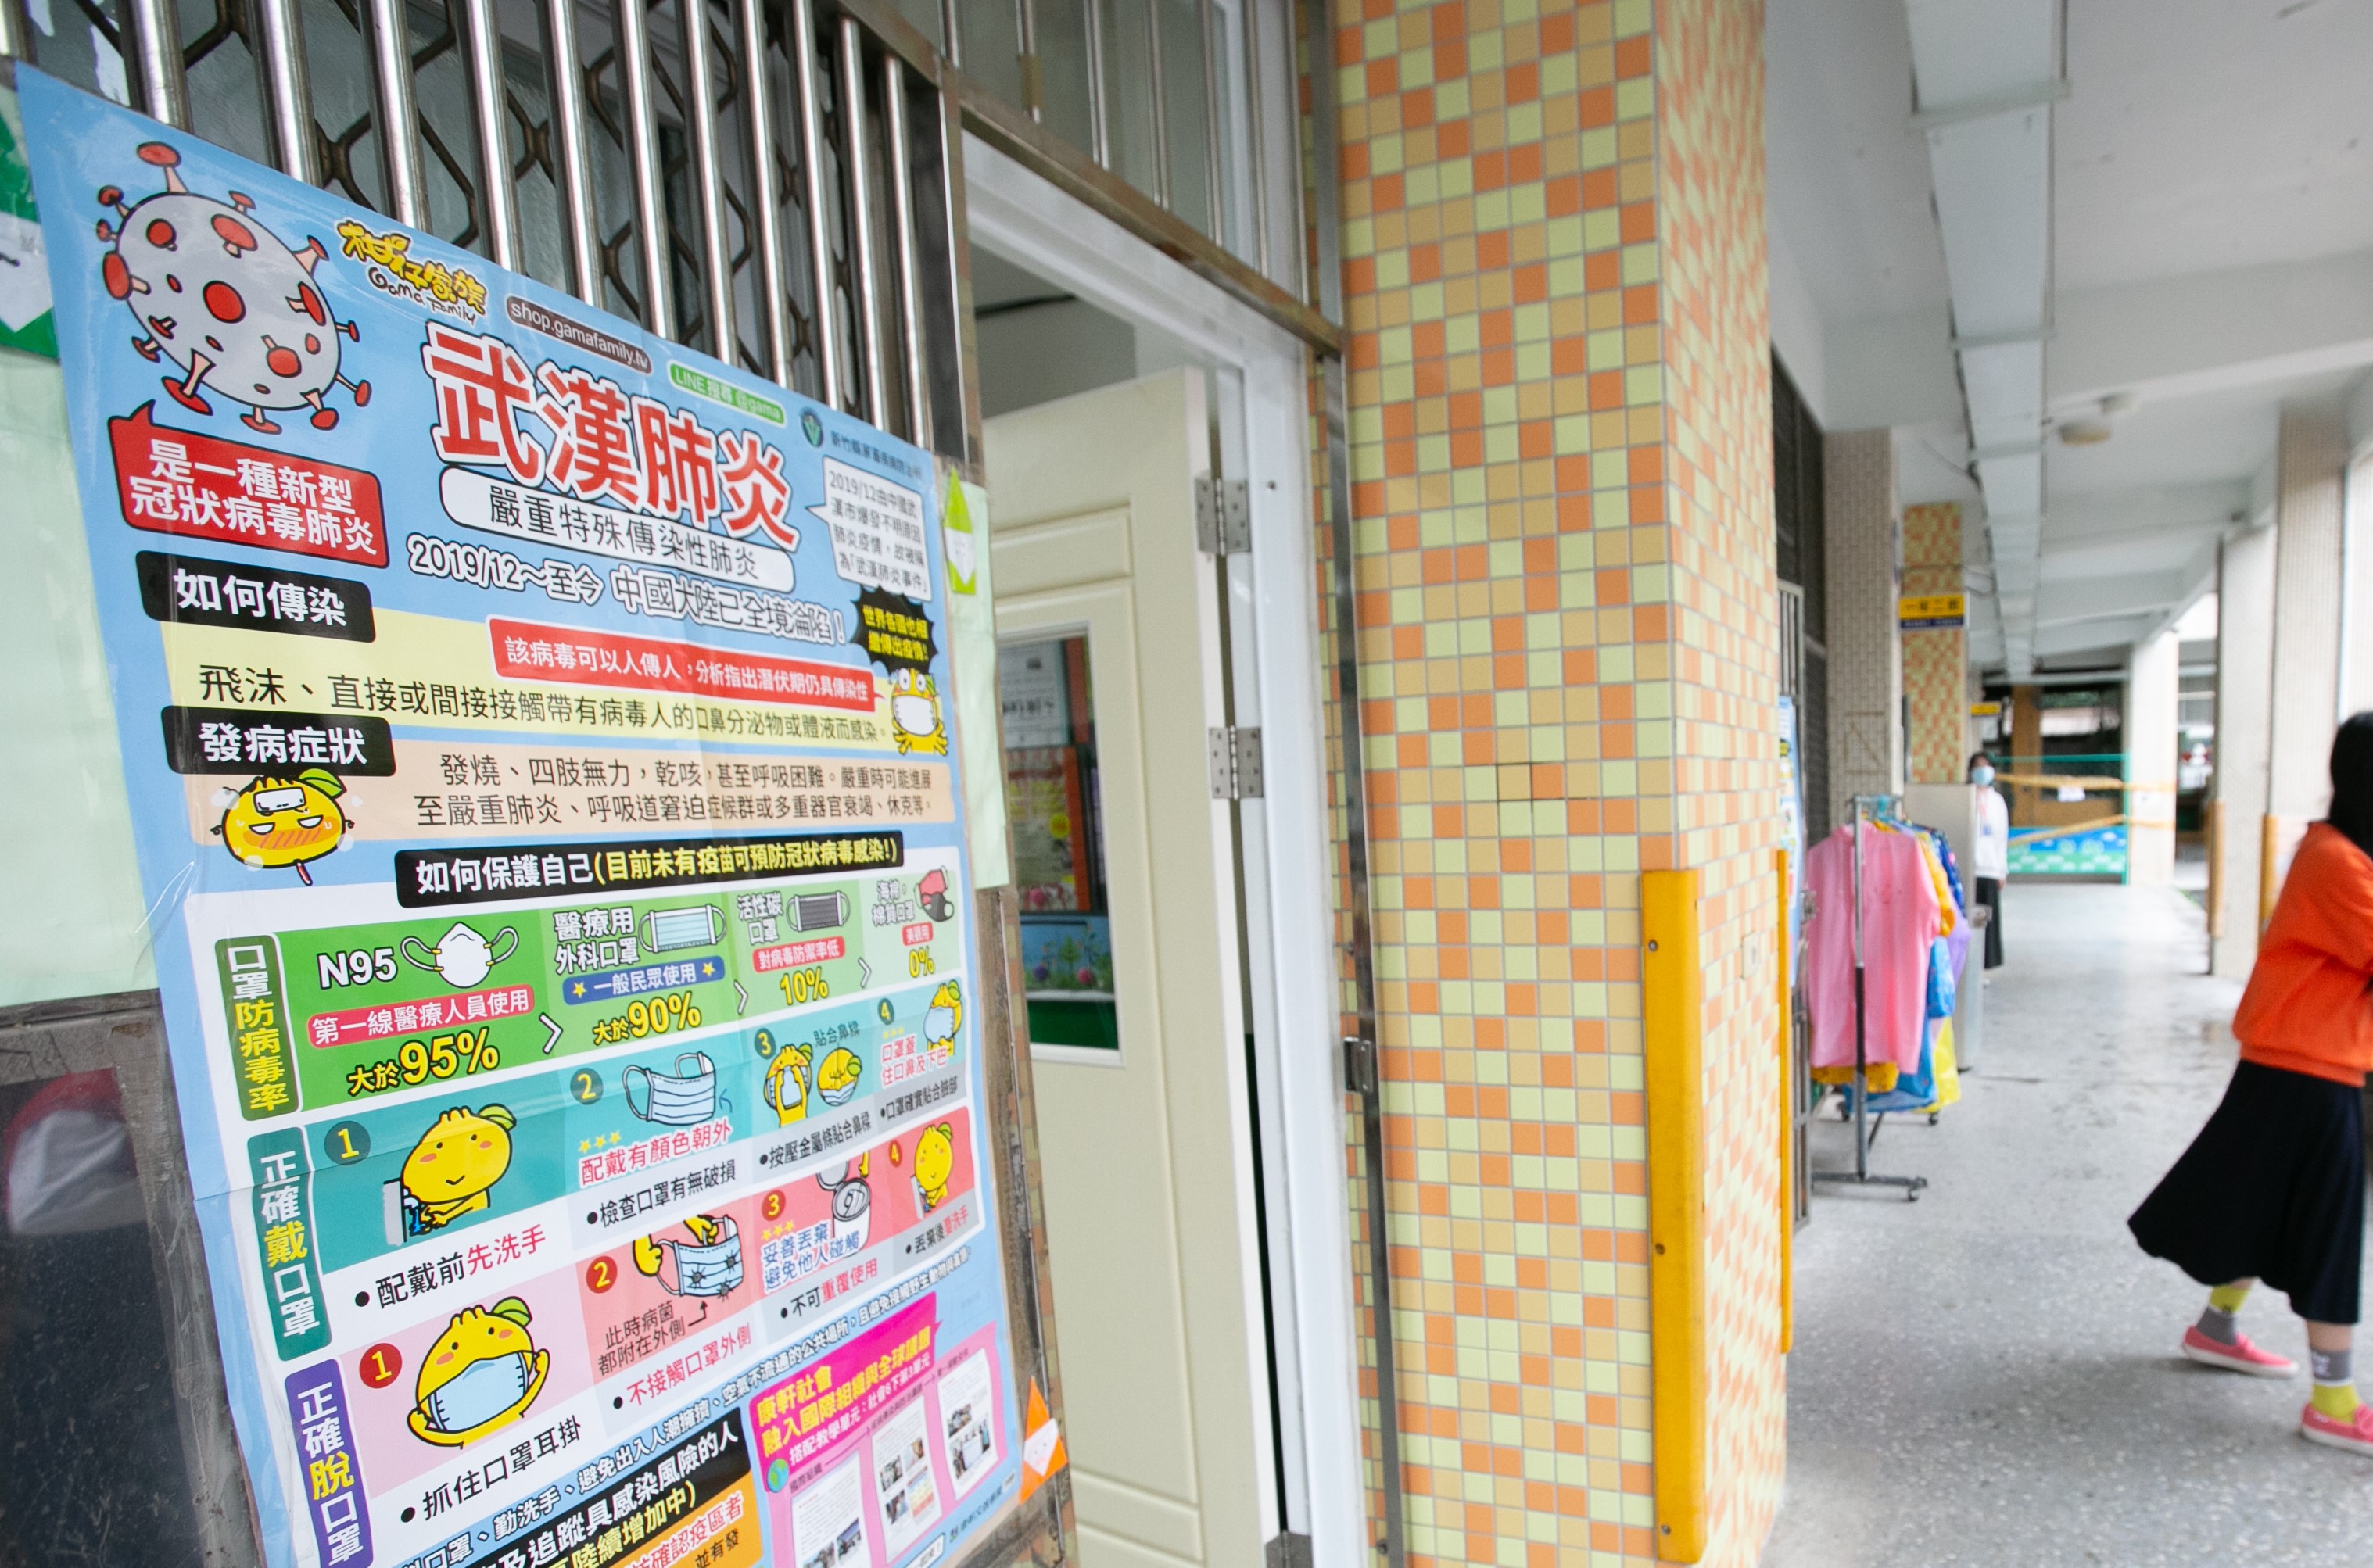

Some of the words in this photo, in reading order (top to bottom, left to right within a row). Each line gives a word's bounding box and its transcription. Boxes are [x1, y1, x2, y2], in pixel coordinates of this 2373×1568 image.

[510, 302, 649, 371] shop.gamafamily.tv
[675, 367, 705, 392] LINE
[427, 324, 798, 550] 武漢肺炎
[149, 438, 353, 514] 是一種新型
[131, 477, 377, 555] 冠狀病毒肺炎
[489, 485, 759, 579] 嚴重特殊傳染性肺炎
[174, 568, 347, 626] 如何傳染
[613, 567, 845, 643] 中國大陸已全境淪陷!
[505, 636, 869, 702] 該病毒可以人傳人，分析指出潛伏期仍具傳染性
[199, 664, 886, 743] 飛沫、直接或間接接觸帶有病毒人的口鼻分泌物或體液而感染。
[198, 721, 367, 765] 發病症狀
[440, 754, 931, 791] 發燒、四肢無力，乾咳，甚至呼吸困難。嚴重時可能進展
[553, 906, 634, 943] 醫療用
[737, 891, 783, 920] 活性碳
[747, 918, 780, 945] 口罩
[317, 947, 397, 989] N95
[555, 937, 640, 975] 外科口罩
[593, 964, 697, 995] 一般民眾使用
[909, 946, 934, 978] 0%
[780, 966, 829, 1005] 10%
[880, 1002, 890, 1021] 4
[227, 944, 289, 1111] 口罩防病毒率
[313, 990, 529, 1045] 第一線醫療人員使用
[593, 992, 701, 1044] 大於90%
[759, 1031, 772, 1055] 3
[814, 1020, 860, 1047] 貼合鼻樑
[348, 1027, 500, 1094] 大於95%
[577, 1073, 597, 1100] 2
[880, 1047, 947, 1086] 住口鼻及下巴
[337, 1129, 360, 1158] 1
[580, 1119, 730, 1185] 配戴有顏色朝外
[769, 1111, 871, 1169] 按壓金屬條貼合鼻樑
[891, 1144, 899, 1163] 4
[600, 1159, 737, 1227] 檢查口罩有無破損
[768, 1194, 780, 1216] 3
[260, 1150, 320, 1335] 正確戴口罩
[376, 1224, 546, 1308] 配戴前先洗手
[763, 1221, 830, 1266] 妥善丟棄
[765, 1231, 859, 1290] 避免他人碰觸
[593, 1262, 610, 1288] 2
[790, 1258, 877, 1317] 不可重覆使用
[598, 1316, 685, 1376] 都附在外側
[605, 1300, 674, 1350] 此時病菌
[371, 1351, 392, 1382] 1
[627, 1321, 751, 1405] 不接觸口罩外側
[757, 1366, 832, 1427] 康軒社會
[297, 1381, 364, 1566] 正確脫口罩
[422, 1415, 582, 1521] 抓住口罩耳掛
